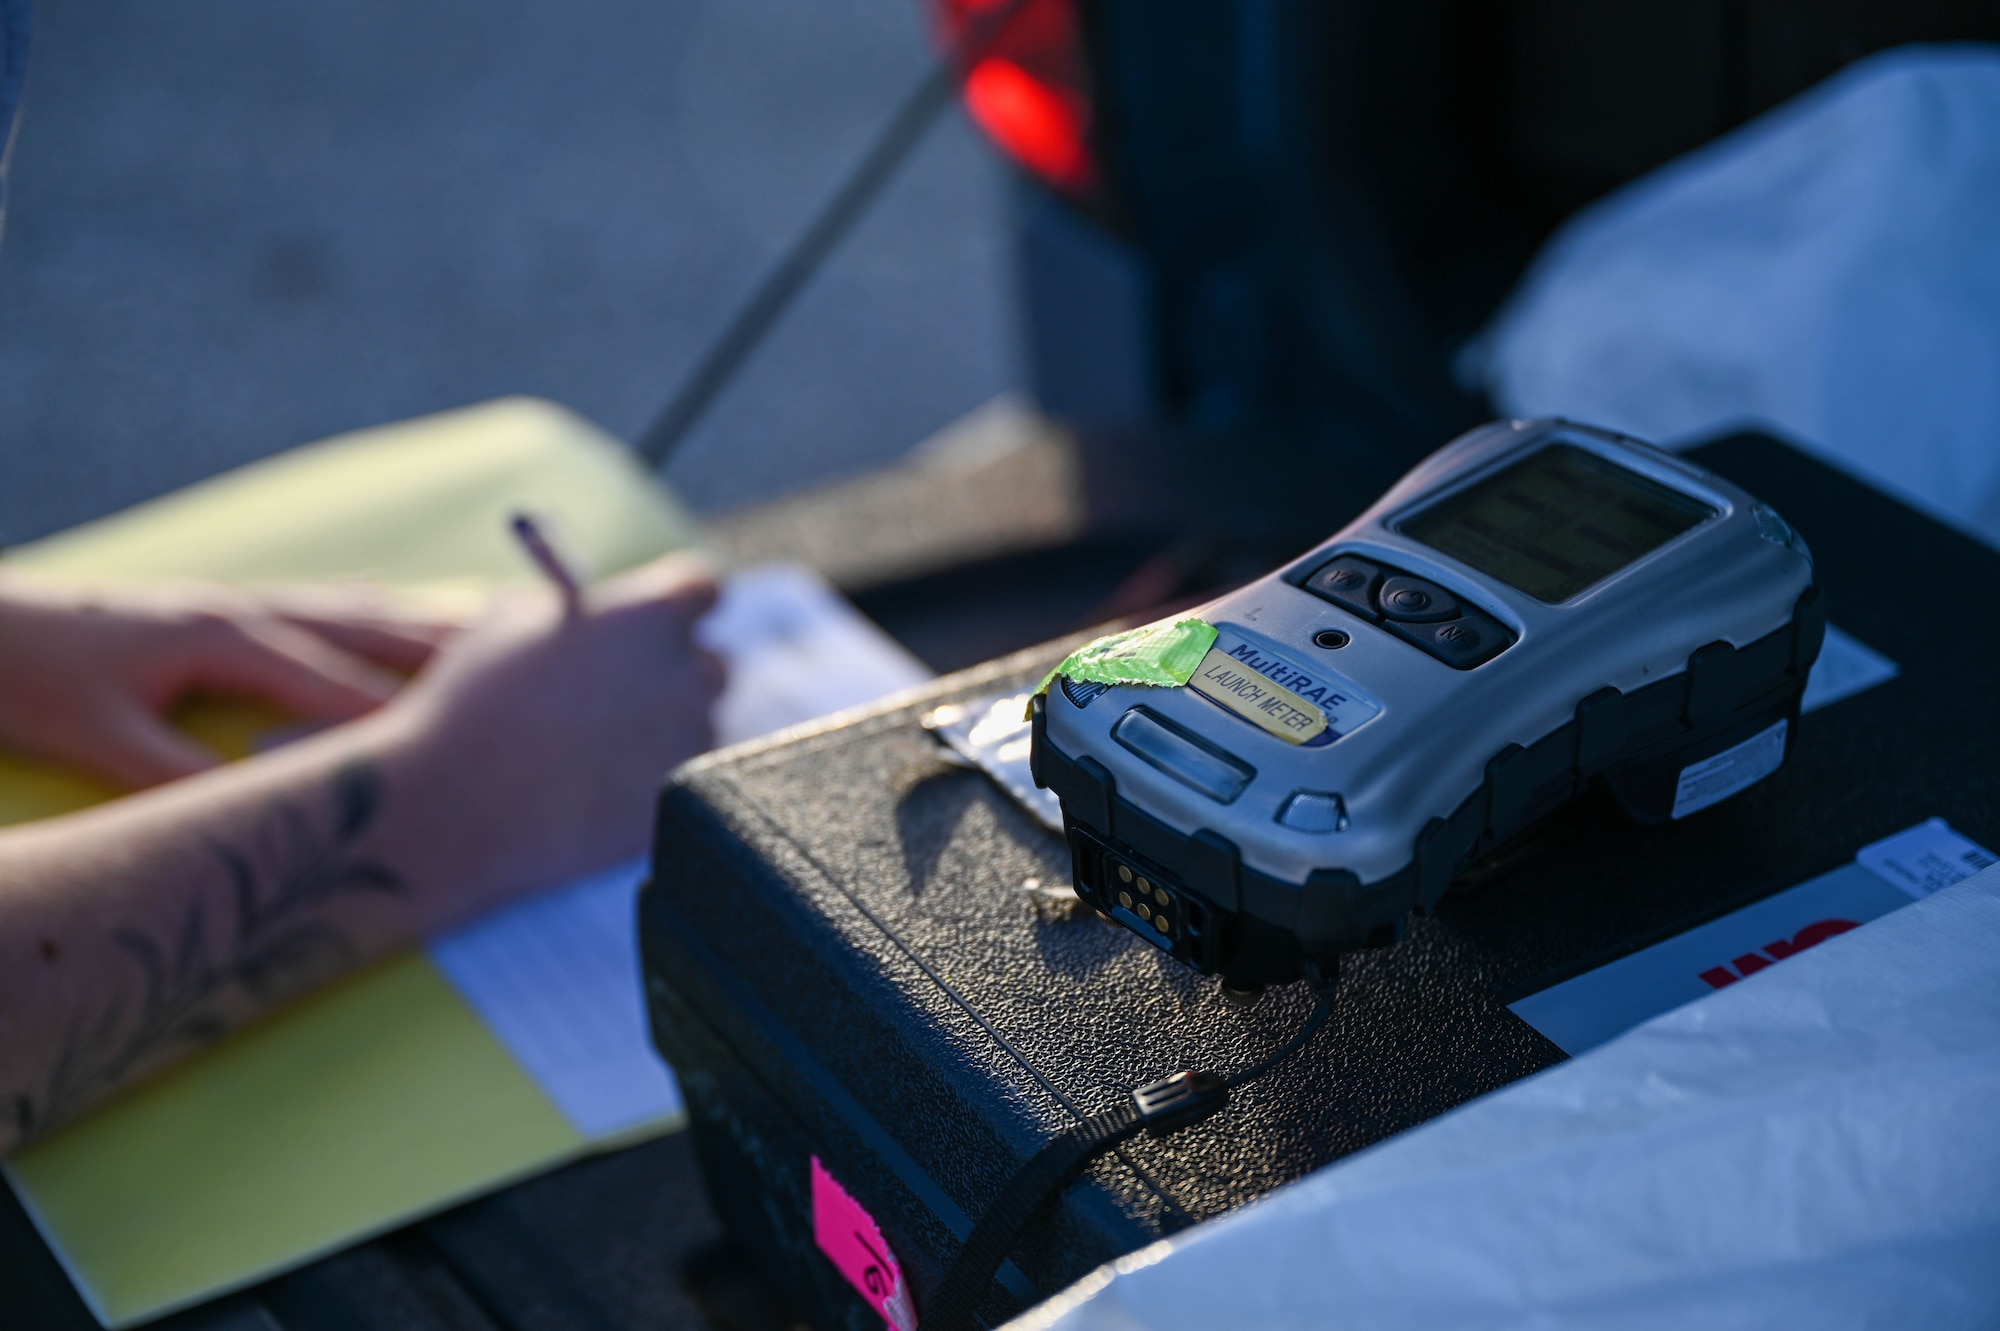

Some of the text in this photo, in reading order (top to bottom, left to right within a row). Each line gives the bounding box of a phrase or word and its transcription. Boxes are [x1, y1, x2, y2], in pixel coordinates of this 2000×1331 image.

[1203, 665, 1314, 732] LAUNCH METER
[1227, 643, 1347, 710] MultiRAE
